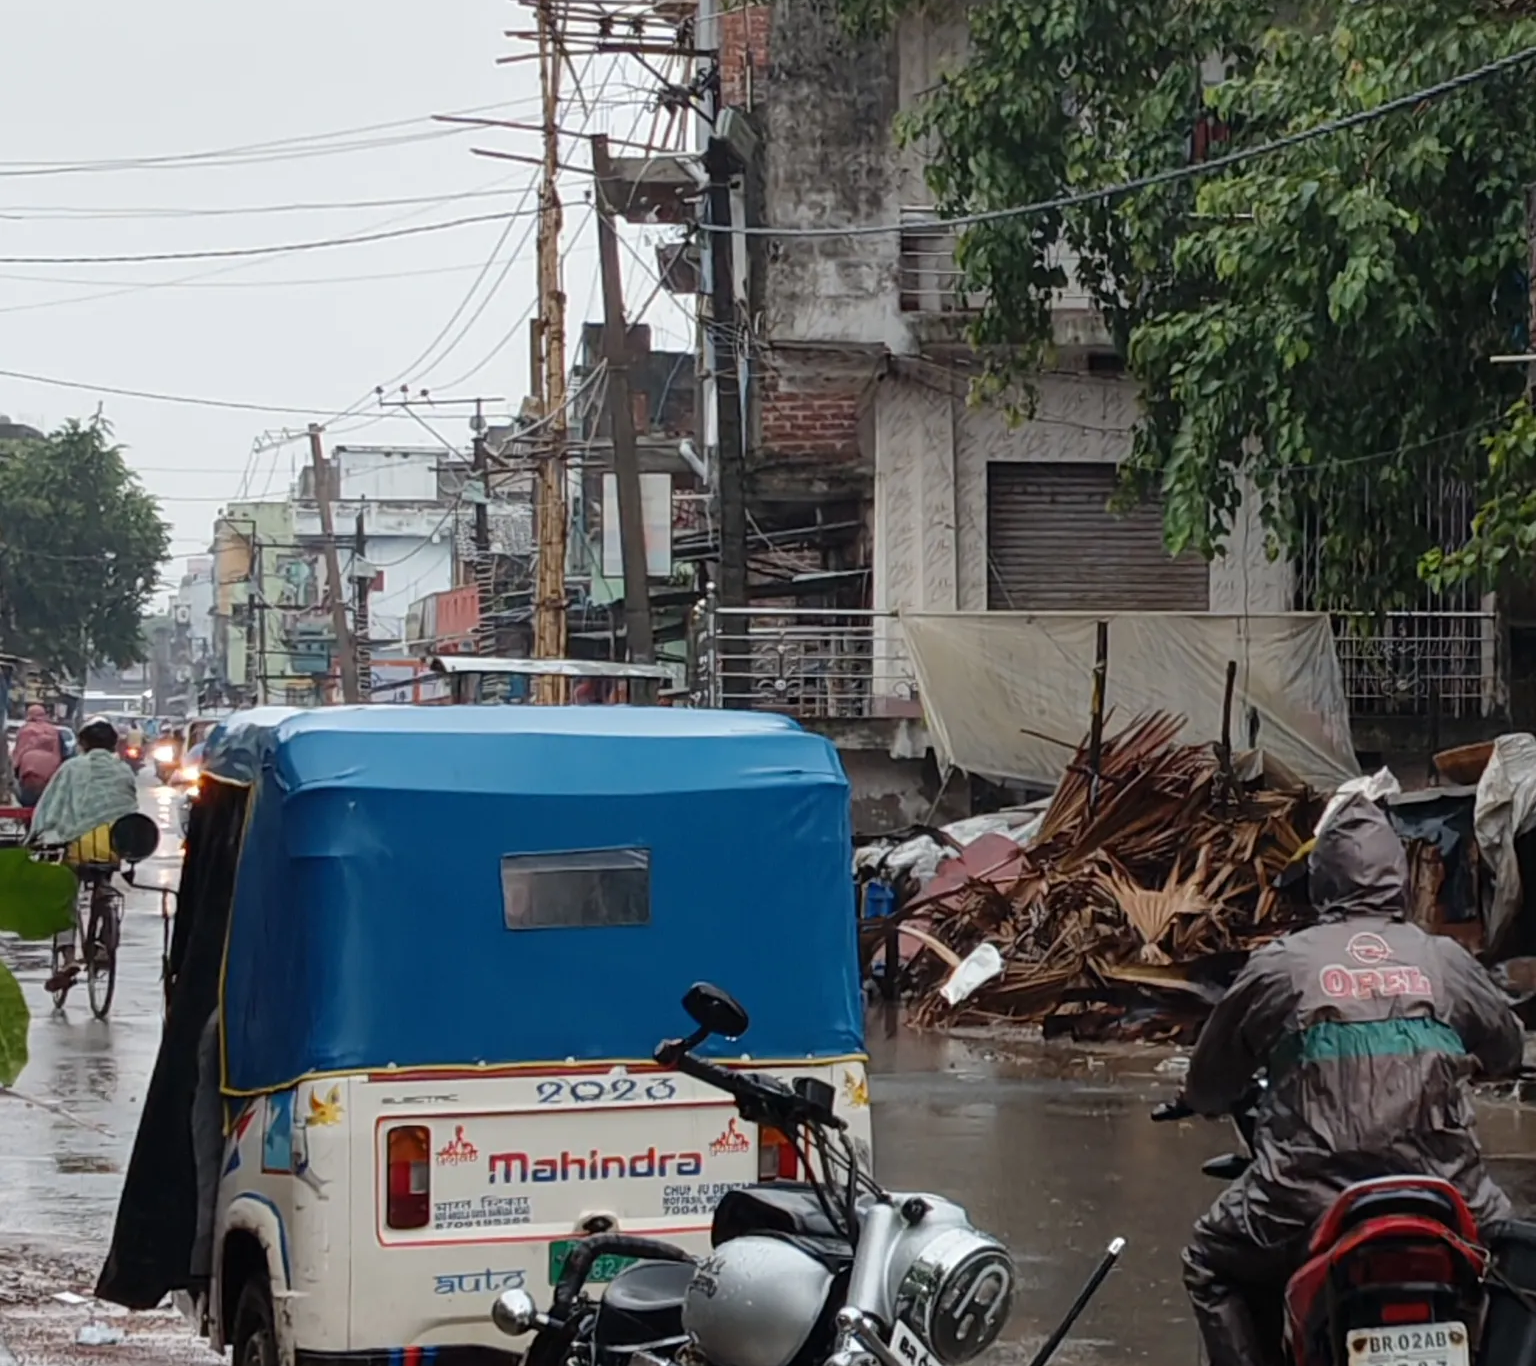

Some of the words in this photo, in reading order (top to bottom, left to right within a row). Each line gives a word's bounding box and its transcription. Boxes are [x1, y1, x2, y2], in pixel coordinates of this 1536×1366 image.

[1319, 963, 1433, 1001] OPEL
[535, 1077, 677, 1105] 2023
[432, 1267, 526, 1295] auto
[898, 1335, 918, 1366] BR
[1369, 1335, 1394, 1354] BR
